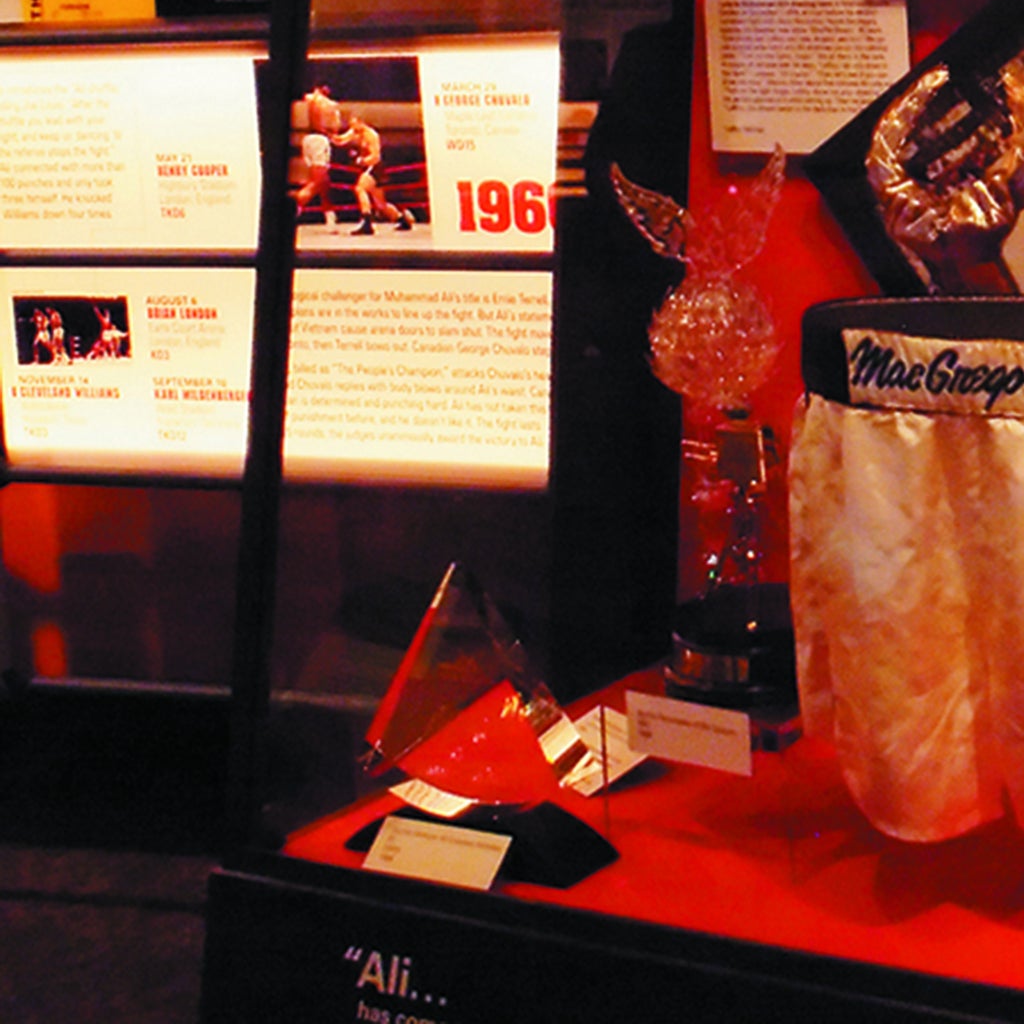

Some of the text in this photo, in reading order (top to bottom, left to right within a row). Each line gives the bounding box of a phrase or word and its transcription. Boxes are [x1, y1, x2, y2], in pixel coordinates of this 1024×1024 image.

[443, 94, 481, 107] GEORGE
[191, 164, 229, 177] COOPER
[147, 296, 188, 305] AUGUST
[18, 376, 75, 385] NOVEMBER
[153, 377, 213, 387] SEPTEMBER
[357, 1000, 390, 1024] has
